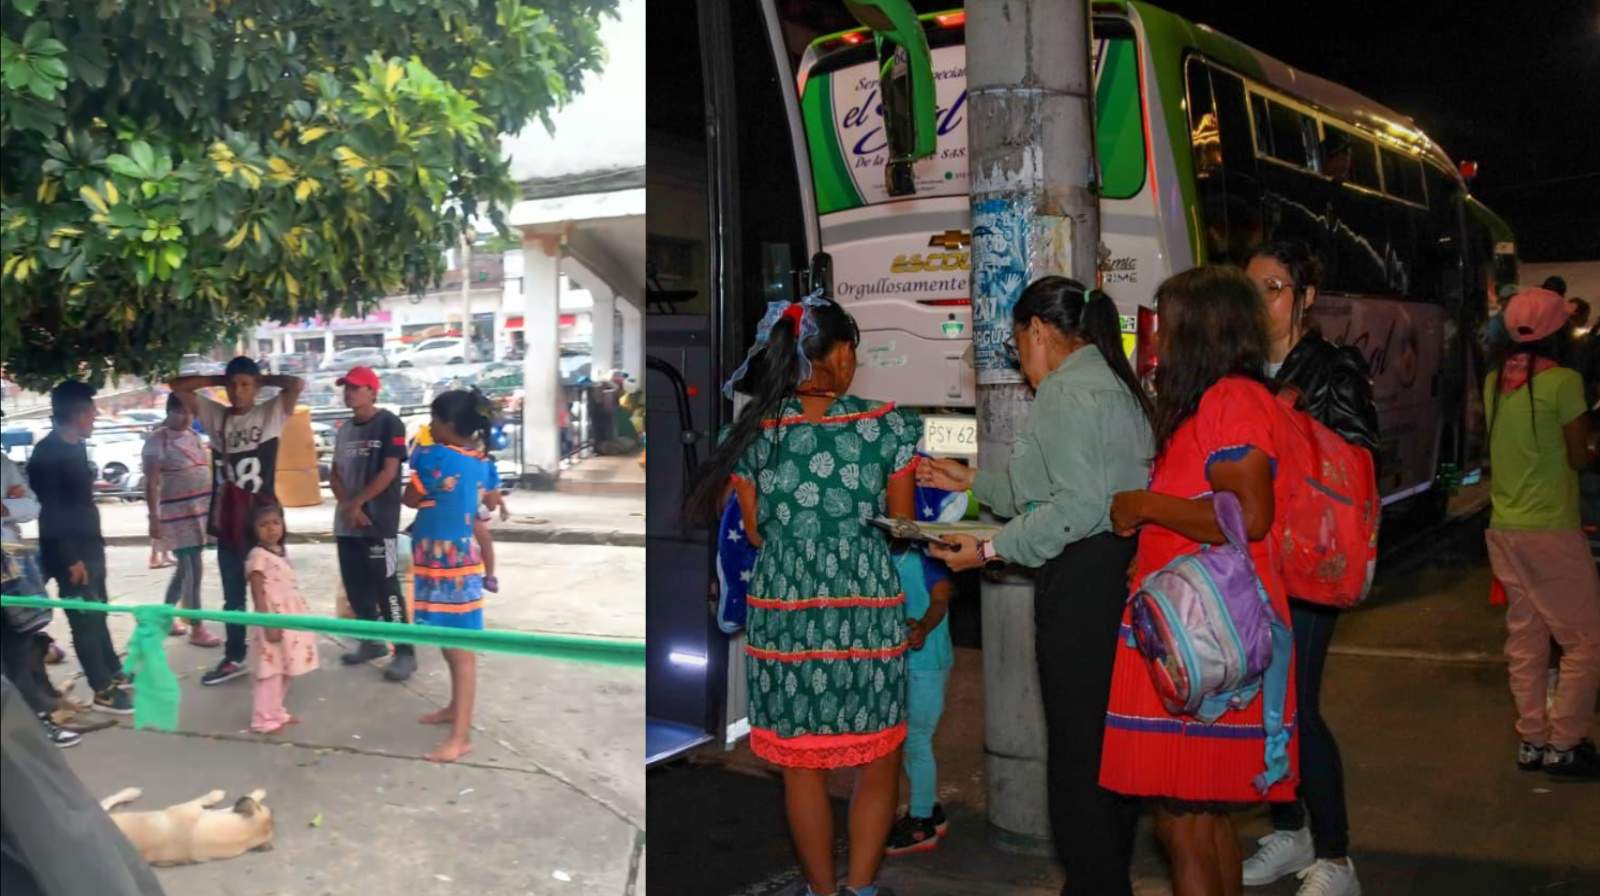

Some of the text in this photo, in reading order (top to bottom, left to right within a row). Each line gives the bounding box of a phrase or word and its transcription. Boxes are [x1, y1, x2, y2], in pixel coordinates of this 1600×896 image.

[843, 89, 877, 128] el
[837, 277, 967, 300] Orgullosamente
[928, 425, 975, 444] PSY 62
